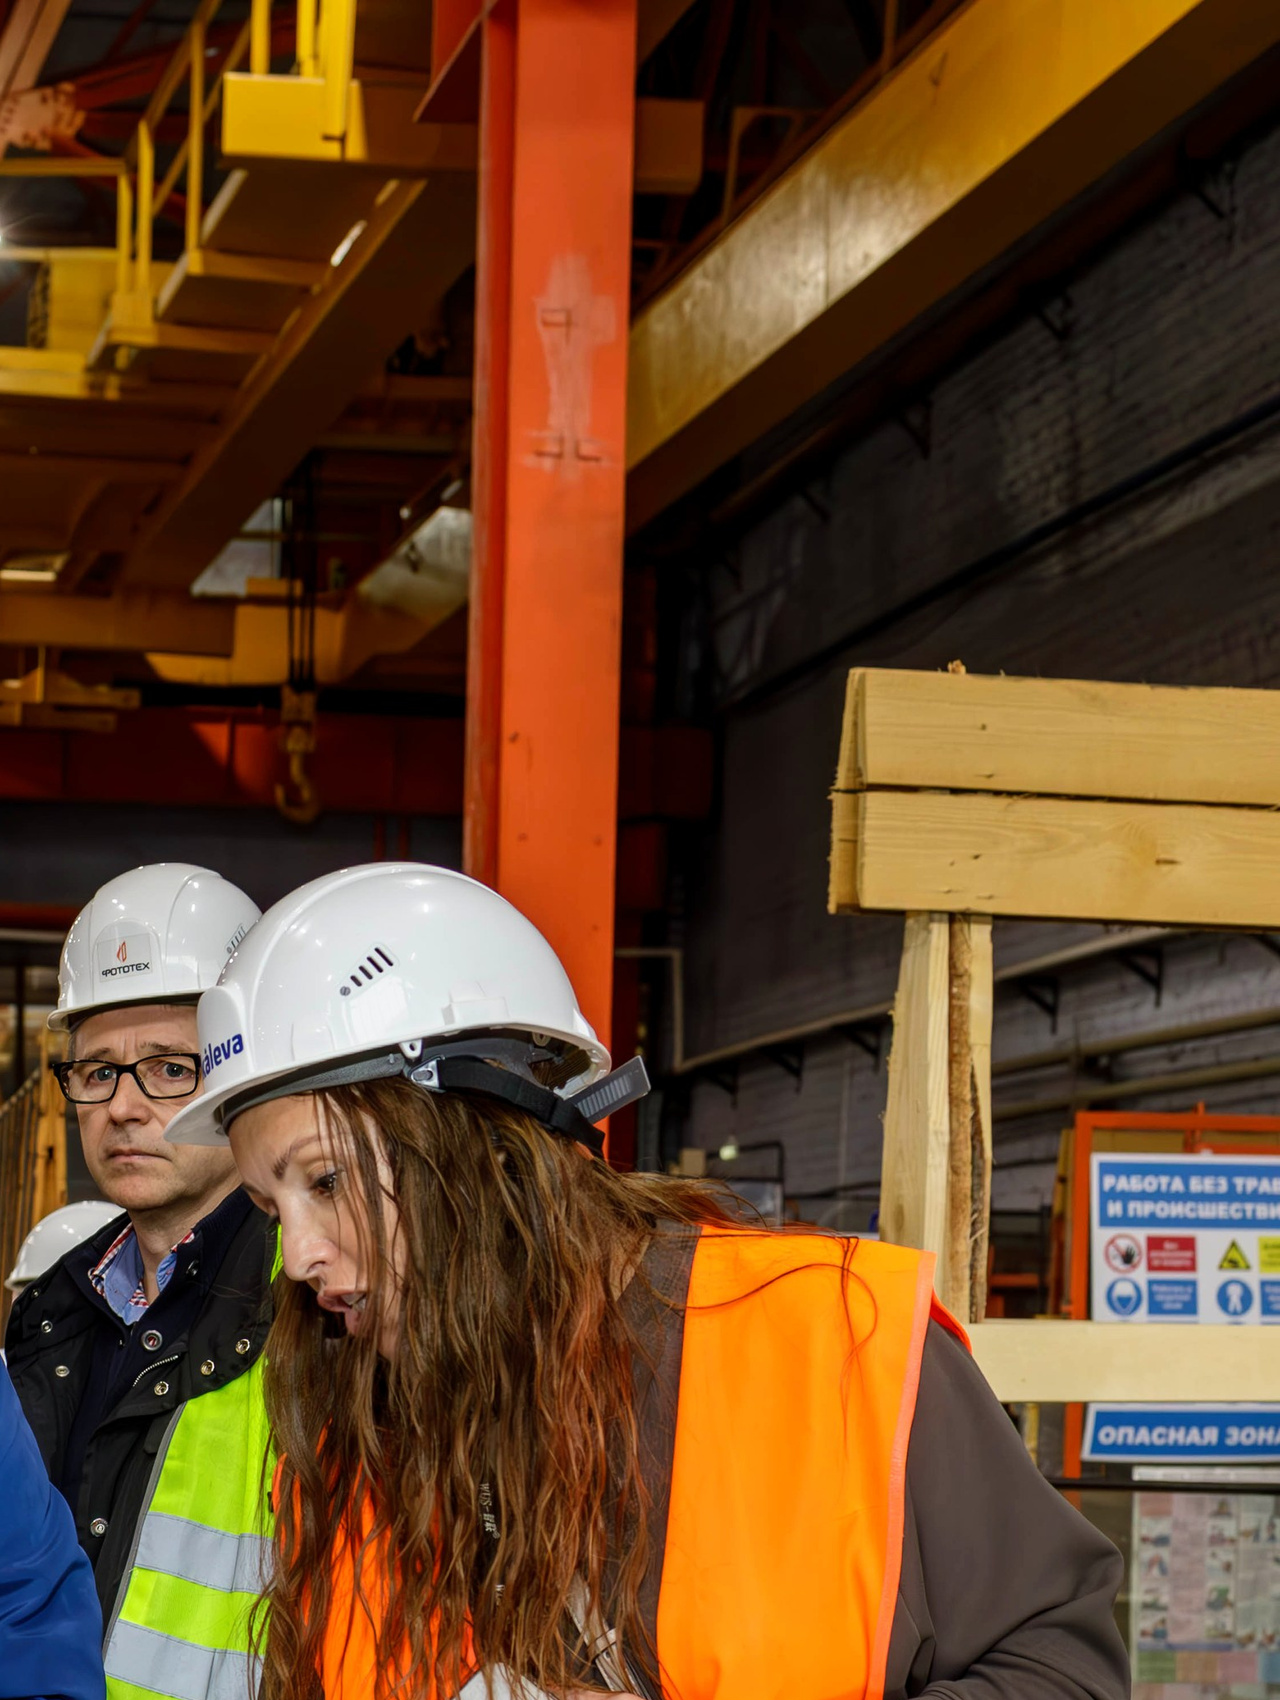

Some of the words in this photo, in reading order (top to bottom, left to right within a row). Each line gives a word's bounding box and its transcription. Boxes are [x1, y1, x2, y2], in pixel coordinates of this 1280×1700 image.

[1103, 1174, 1185, 1193] РАБОТА
[1190, 1175, 1228, 1194] БЕЗ
[1107, 1200, 1123, 1218] И
[1098, 1425, 1219, 1446] ОПАСНАЯ
